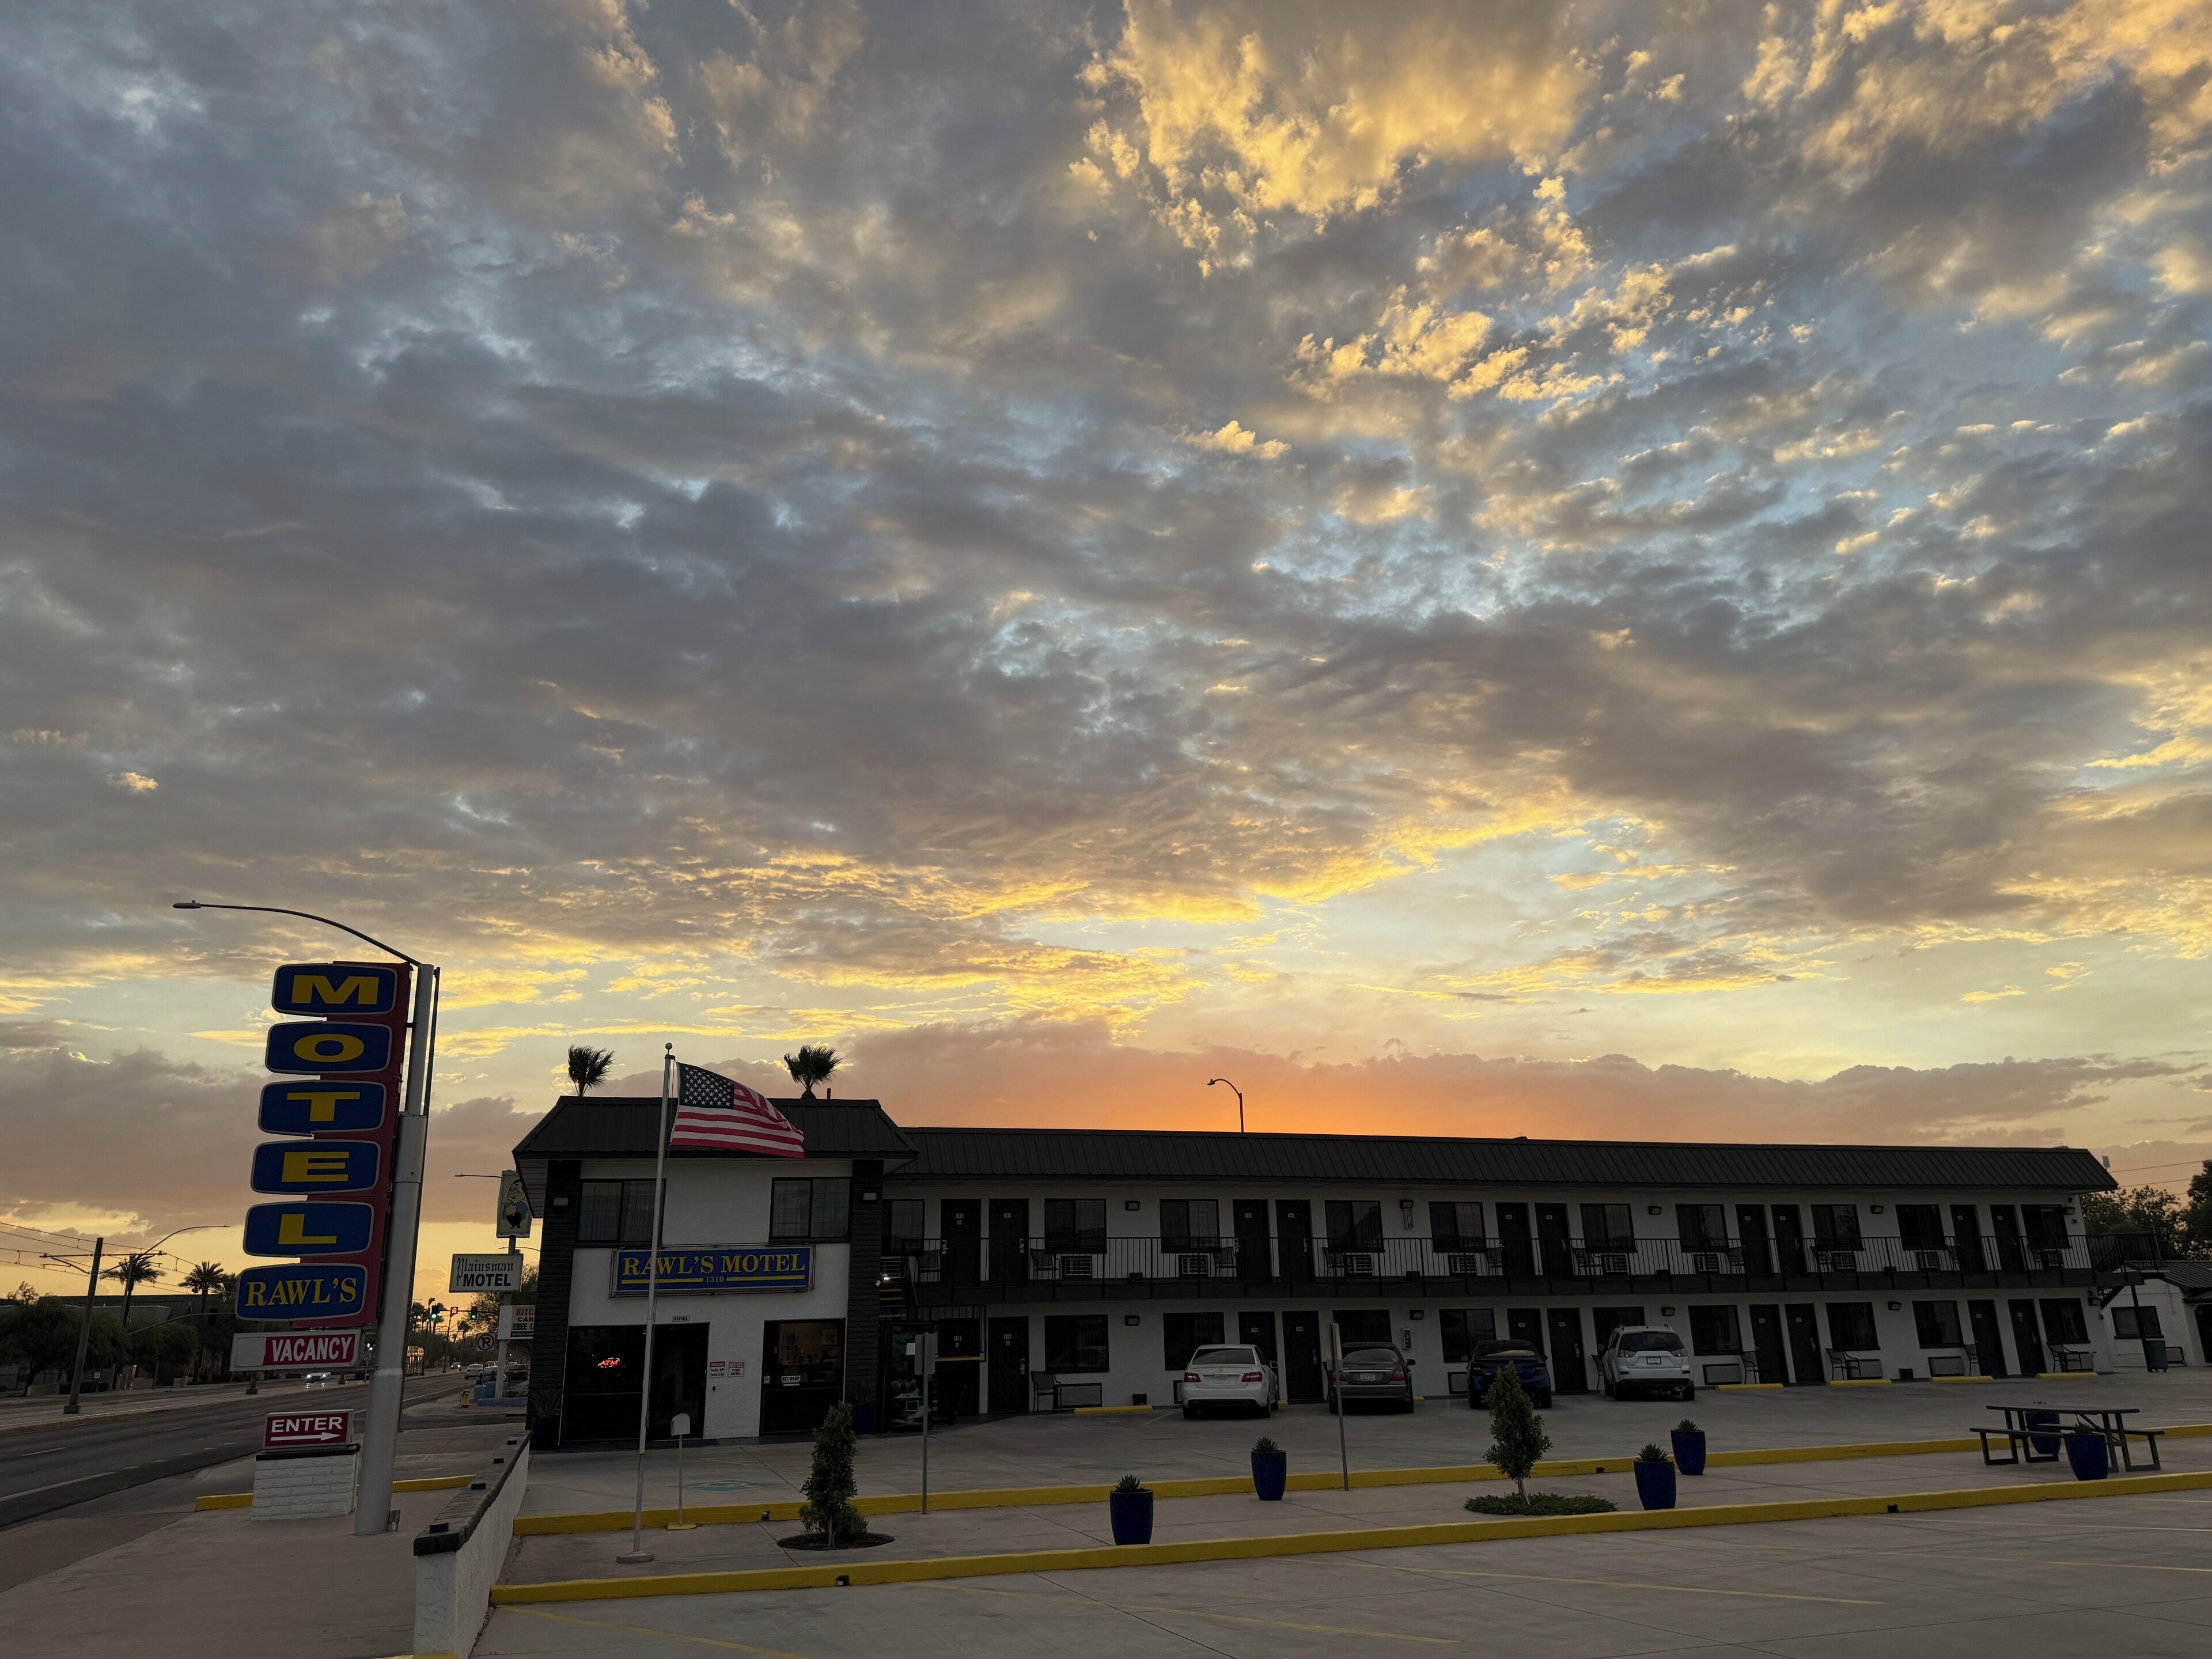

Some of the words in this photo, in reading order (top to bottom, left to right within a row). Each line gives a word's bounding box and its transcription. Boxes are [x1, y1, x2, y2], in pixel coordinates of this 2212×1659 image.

[278, 975, 378, 1245] MOTEL
[456, 1257, 513, 1286] Plainsman
[622, 1255, 714, 1275] RAWL'S
[721, 1253, 805, 1272] MOTEL
[244, 1277, 357, 1306] RAWL'S
[463, 1274, 511, 1286] MOTEL
[271, 1337, 353, 1362] VACANCY
[271, 1417, 343, 1433] ENTER
